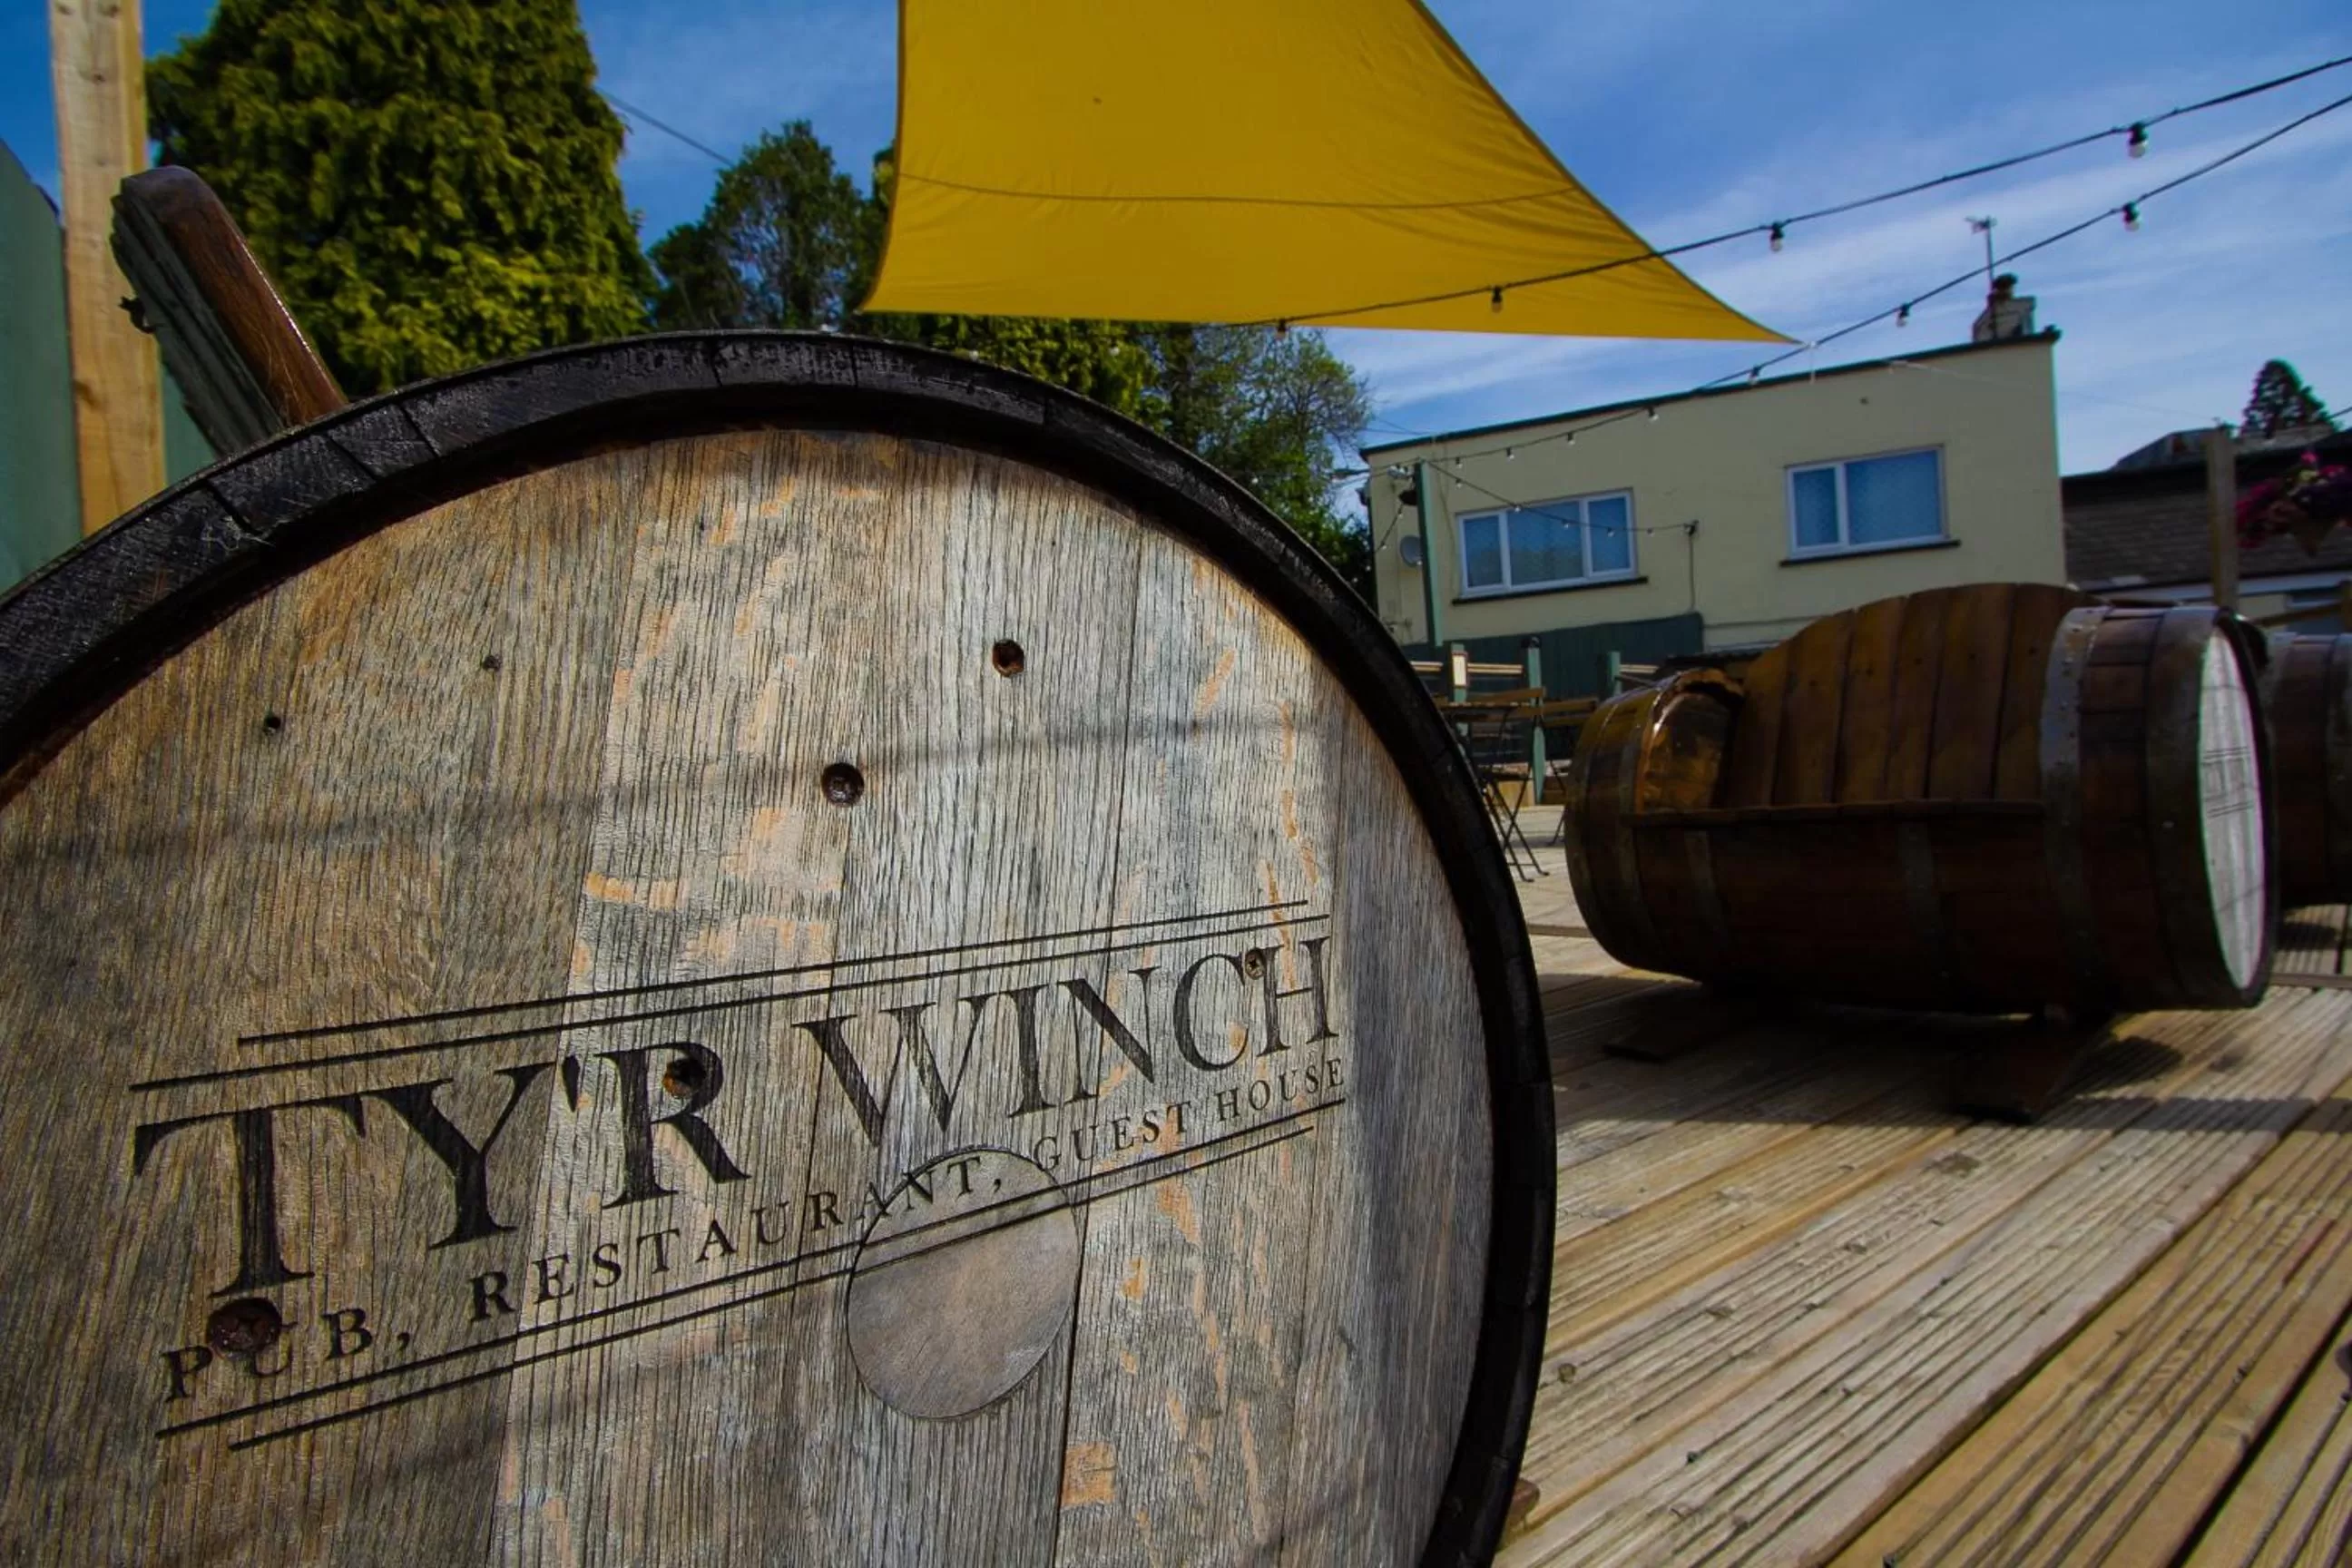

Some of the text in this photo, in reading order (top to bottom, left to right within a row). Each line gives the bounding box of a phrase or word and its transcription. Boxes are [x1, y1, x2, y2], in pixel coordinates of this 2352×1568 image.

[133, 936, 1340, 1298] TY'R WINCH
[469, 1154, 1003, 1323] RESTAURANT,
[1031, 1100, 1193, 1172] GUEST
[1215, 1058, 1346, 1123] HOUSE
